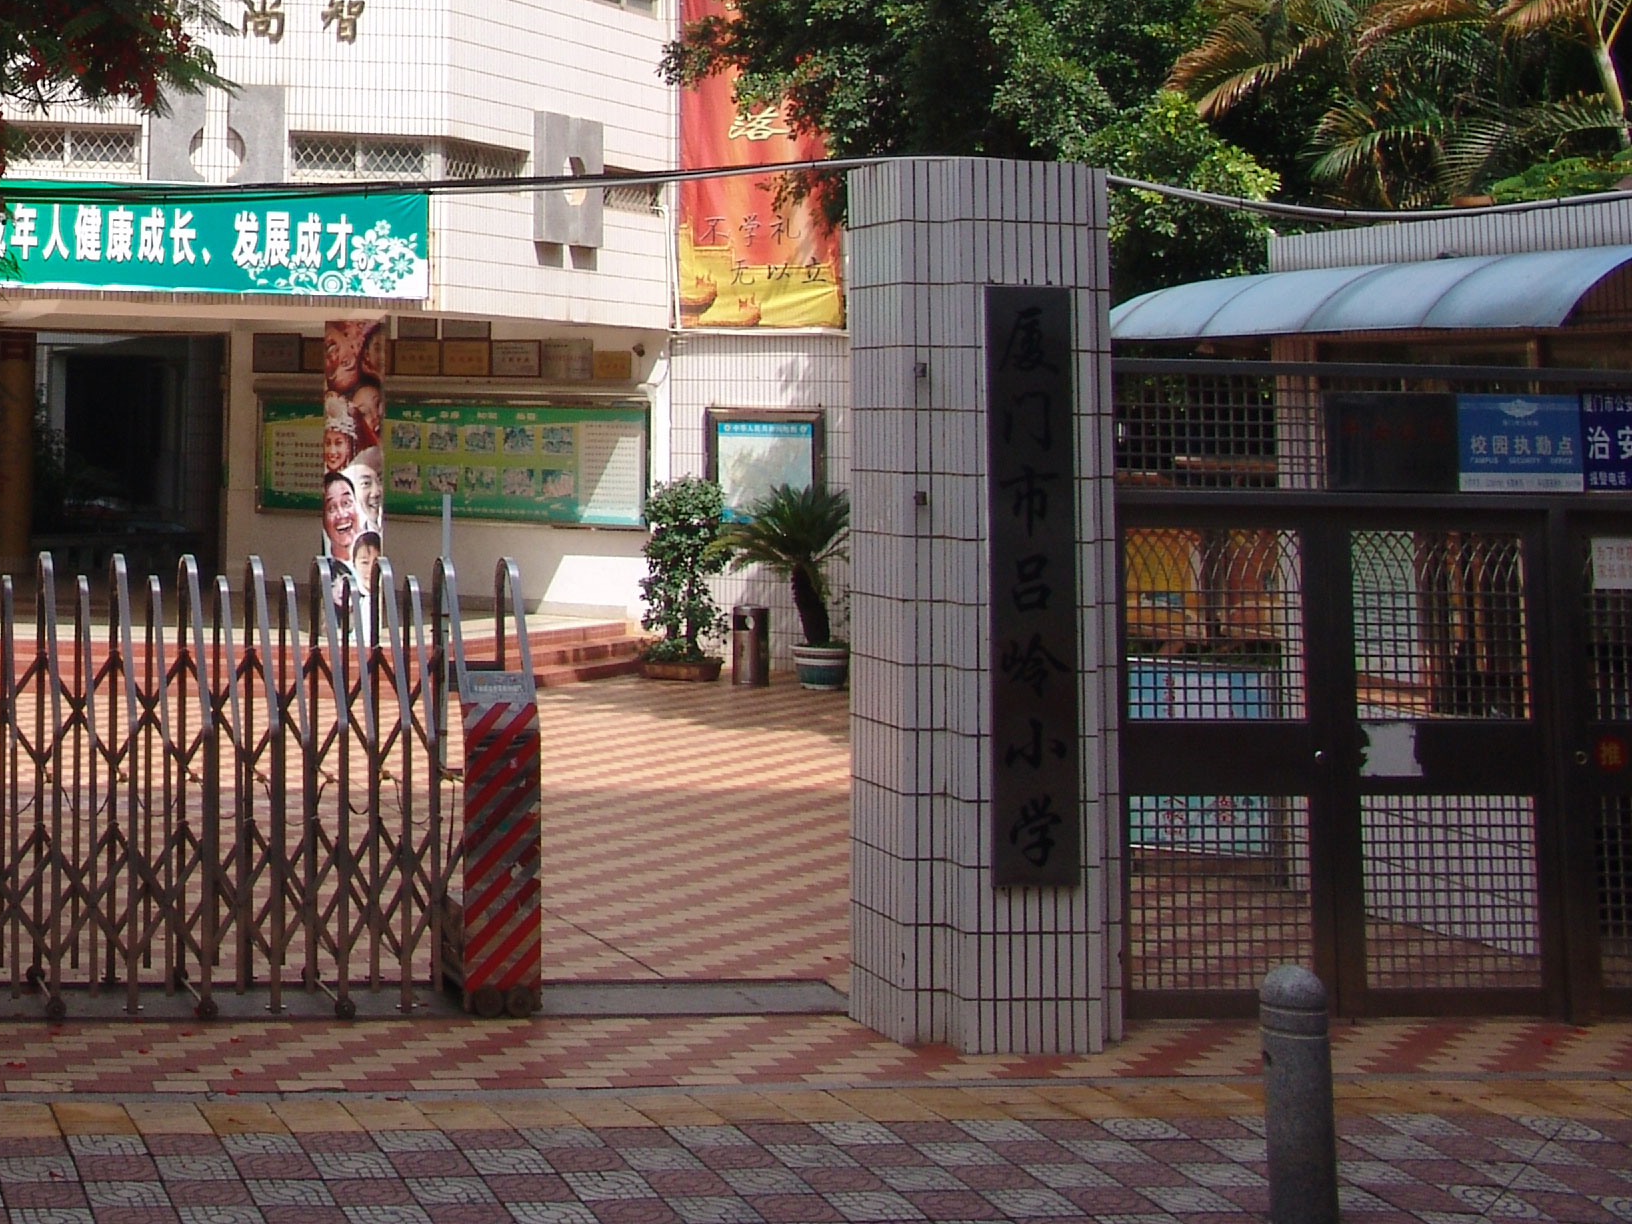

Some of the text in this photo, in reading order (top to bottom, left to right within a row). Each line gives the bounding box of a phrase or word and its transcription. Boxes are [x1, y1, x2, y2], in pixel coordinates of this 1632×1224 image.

[698, 213, 802, 247] 不学礼
[729, 256, 829, 287] 无以立
[1470, 435, 1573, 456] 校园执勤点
[997, 306, 1068, 868] 厦门市吕岭小学
[1600, 742, 1621, 765] 推
